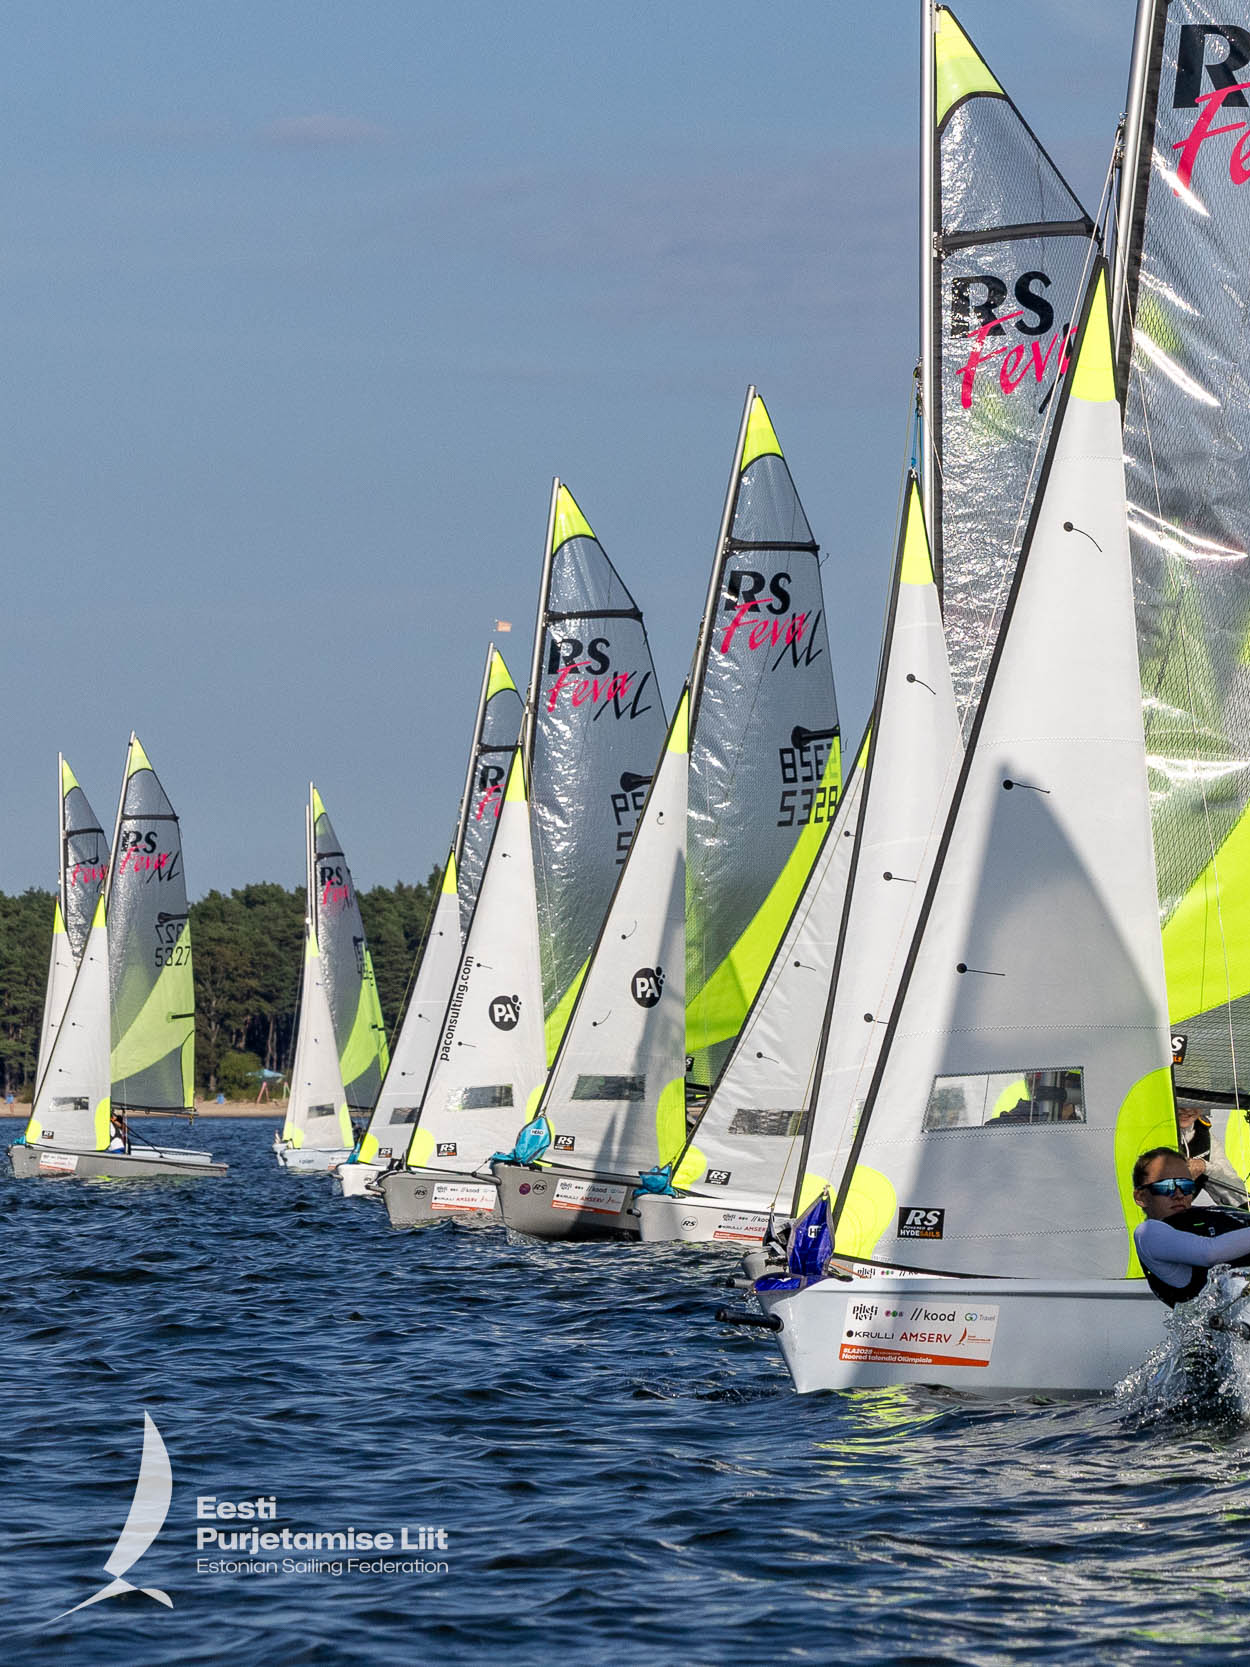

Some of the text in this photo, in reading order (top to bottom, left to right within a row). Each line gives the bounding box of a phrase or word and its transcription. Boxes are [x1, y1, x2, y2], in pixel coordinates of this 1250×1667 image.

[951, 271, 1054, 338] RS
[724, 570, 791, 615] RS
[721, 598, 822, 672] Feva XL
[548, 638, 610, 675] RS
[547, 661, 652, 721] Feva XL
[777, 785, 838, 828] 5328
[121, 831, 157, 853] RS
[320, 866, 343, 886] RS
[155, 946, 191, 967] 5327
[636, 976, 659, 998] PA
[440, 955, 474, 1061] paconsulting.com
[493, 1004, 517, 1022] PA
[440, 1144, 456, 1152] RS
[558, 1136, 574, 1145] RS
[709, 1170, 728, 1180] RS
[905, 1210, 940, 1226] RS
[855, 1331, 953, 1344] KRULLI AMSERV
